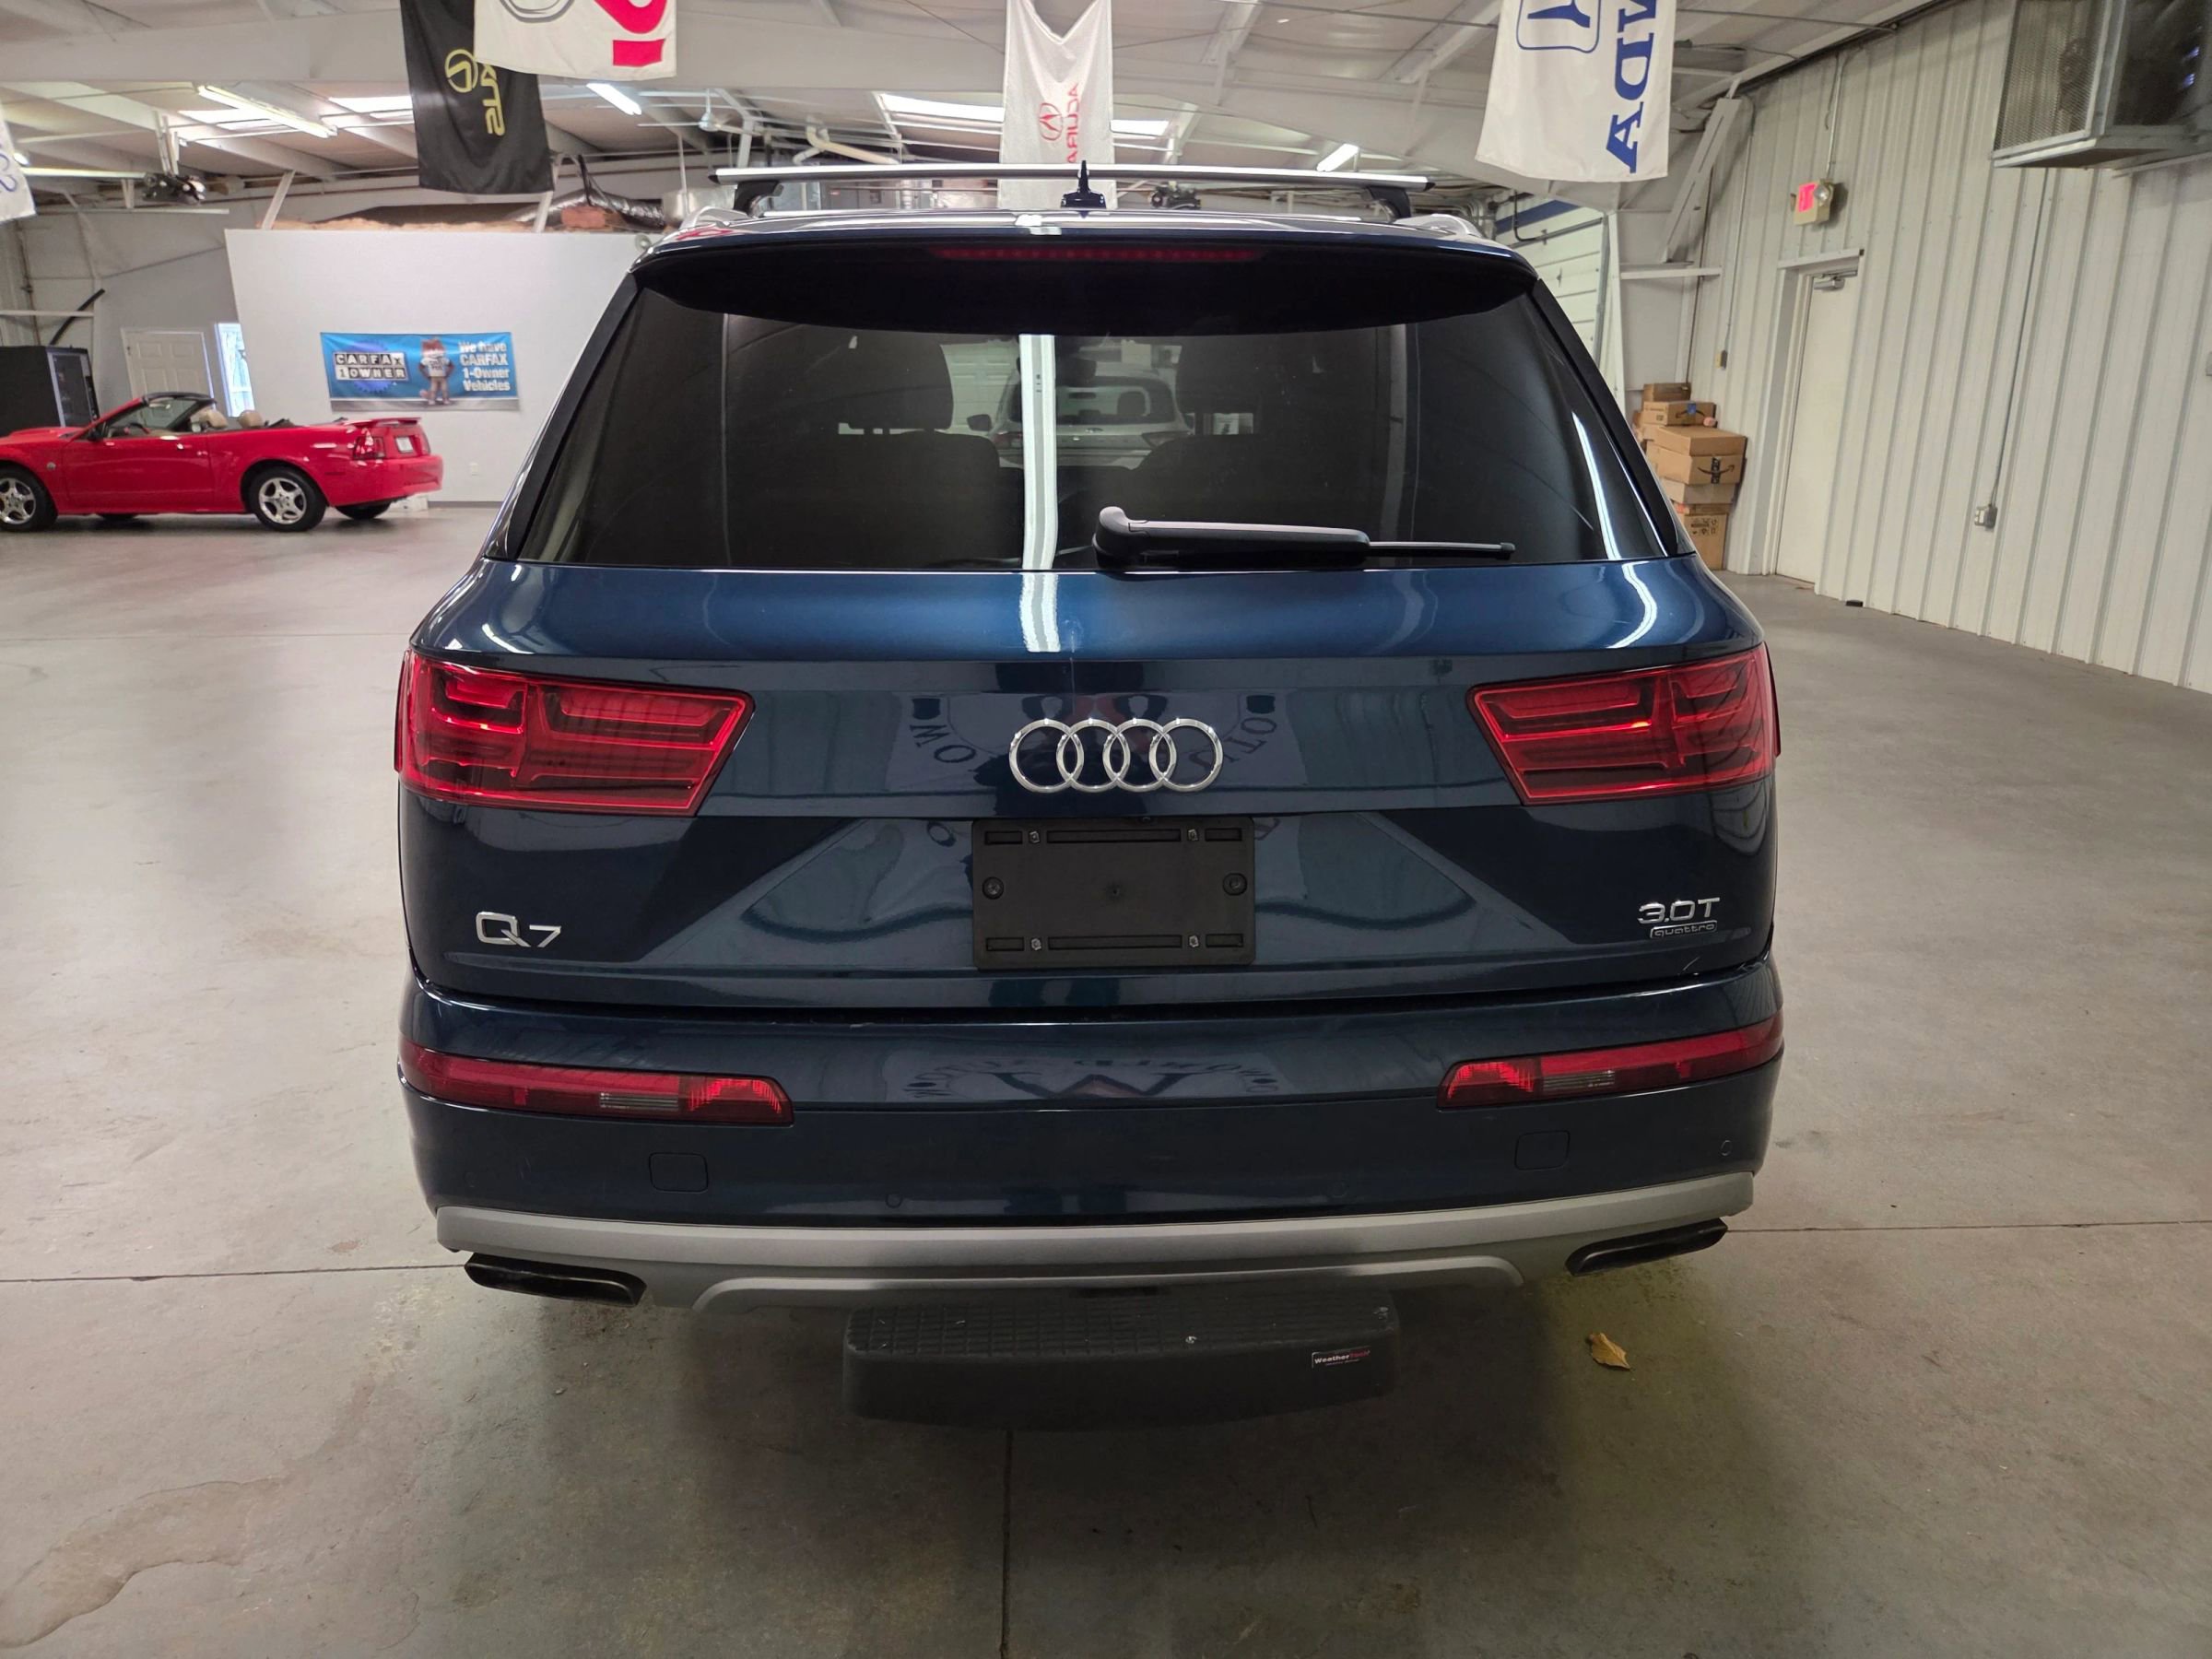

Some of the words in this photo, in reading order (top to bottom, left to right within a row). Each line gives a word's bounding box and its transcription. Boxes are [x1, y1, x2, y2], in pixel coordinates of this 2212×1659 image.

[459, 342, 477, 353] We
[478, 341, 507, 353] have
[335, 354, 404, 366] CARFAX
[460, 353, 509, 366] CARFAX
[462, 367, 510, 379] 1-Owner
[463, 379, 511, 392] Vehicles
[1637, 897, 1721, 924] 3.0T
[476, 911, 562, 948] Q7
[1653, 924, 1715, 938] quattro
